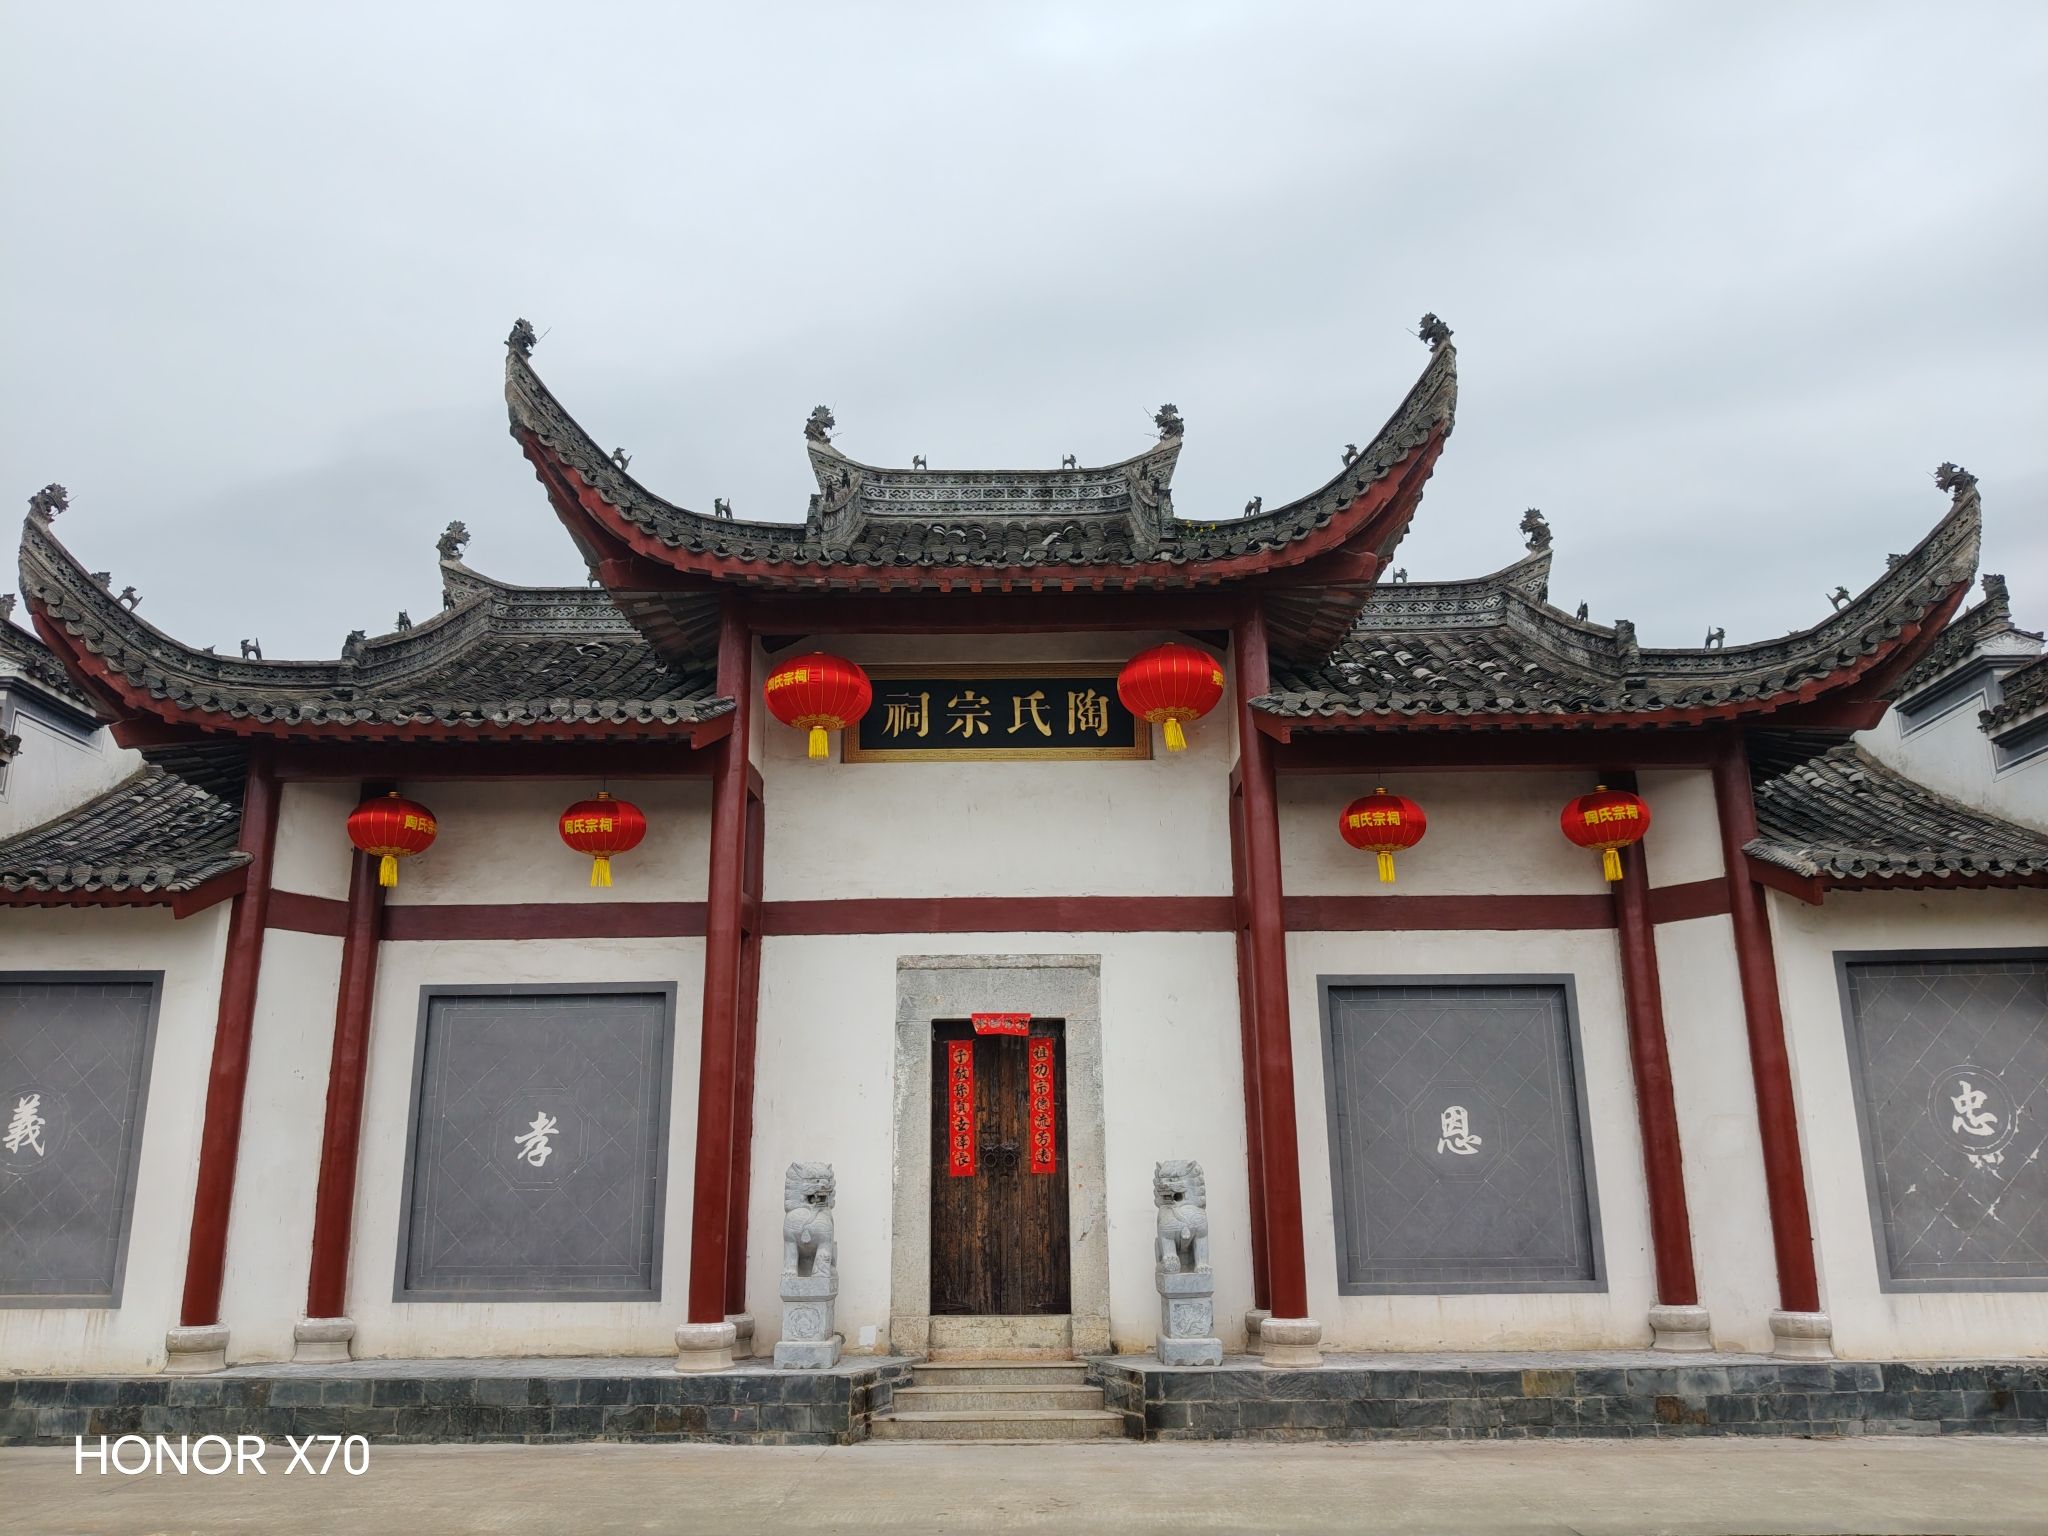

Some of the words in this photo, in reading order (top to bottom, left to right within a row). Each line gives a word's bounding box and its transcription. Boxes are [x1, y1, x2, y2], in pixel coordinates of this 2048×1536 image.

[564, 817, 613, 834] 陶氏宗祠
[1349, 810, 1400, 829] 陶氏宗祠
[1584, 804, 1638, 826] 陶氏宗祠
[2, 1093, 46, 1157] 義
[1437, 1105, 1482, 1155] 恩
[1950, 1080, 1998, 1136] 忠
[514, 1111, 560, 1167] 孝
